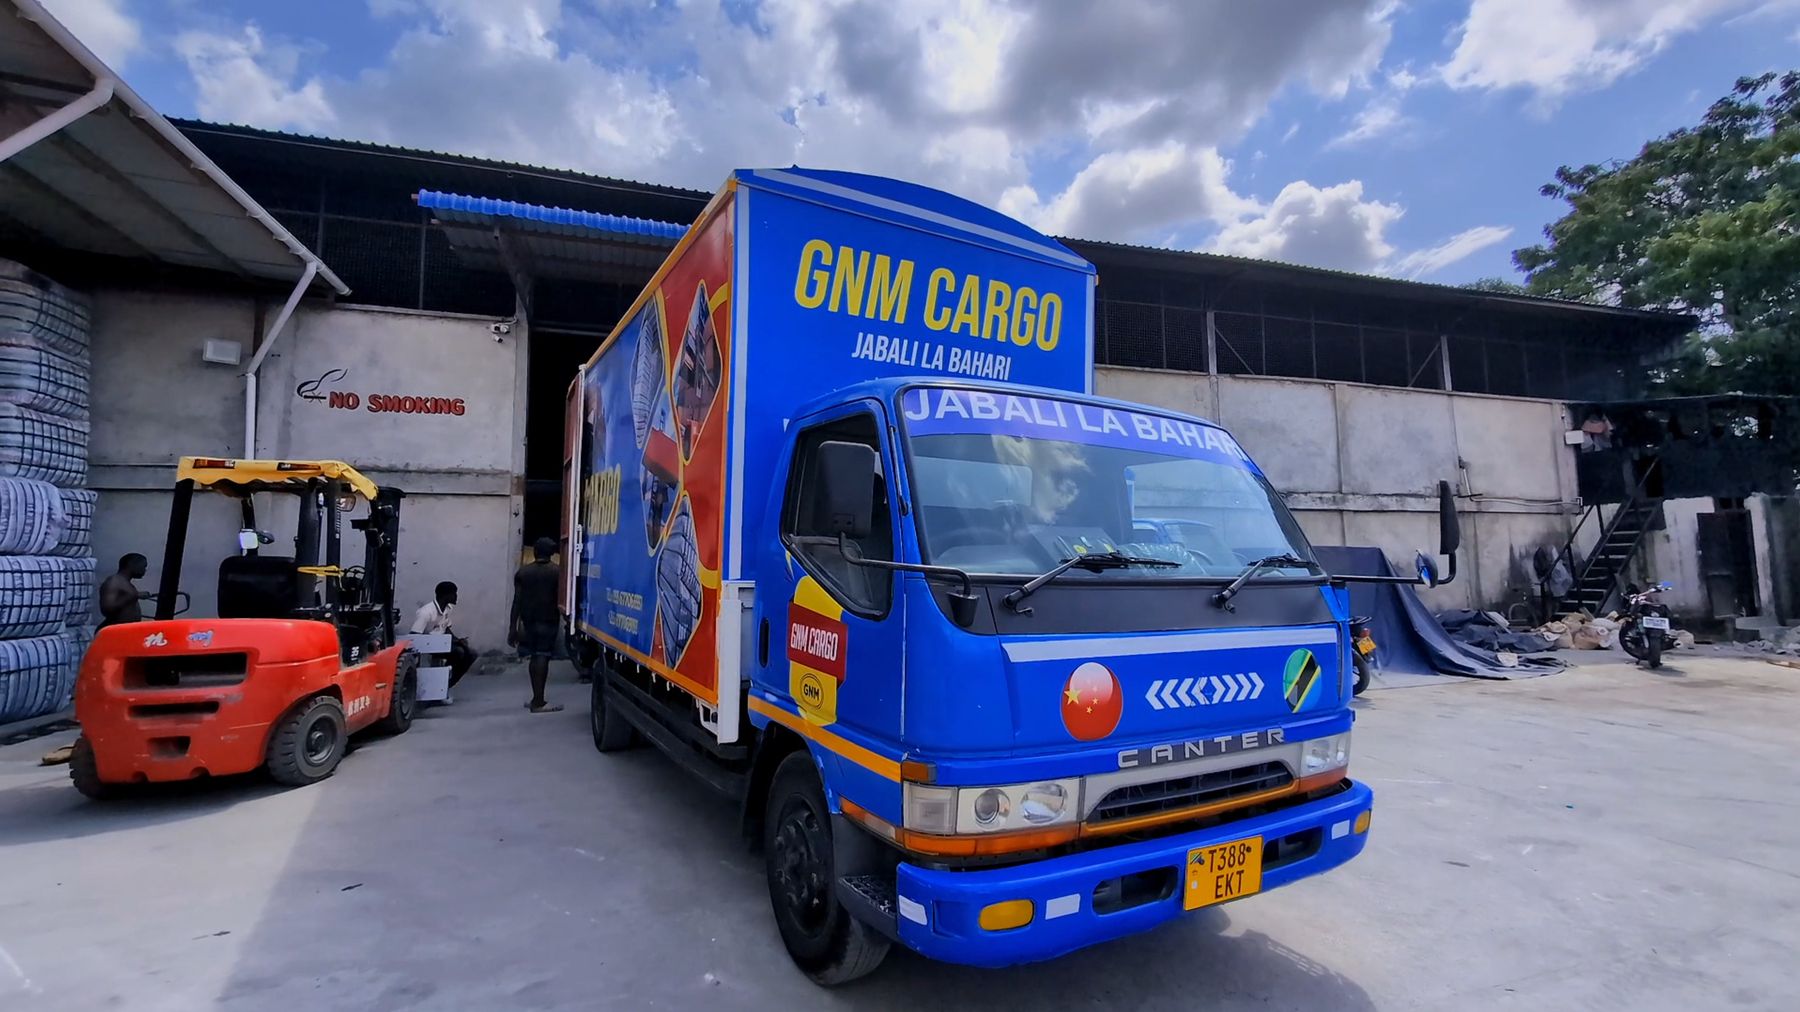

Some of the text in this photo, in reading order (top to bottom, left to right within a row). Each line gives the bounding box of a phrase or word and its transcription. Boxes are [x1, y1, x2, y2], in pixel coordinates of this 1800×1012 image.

[794, 239, 1063, 351] GNM CARGO
[851, 332, 1012, 381] JABALI LA BAHARI
[329, 390, 466, 416] NO SMOKING
[905, 388, 1068, 428] JABALI
[1074, 404, 1128, 437] LA
[790, 622, 838, 661] GNM CARGO
[803, 683, 820, 701] GNM
[1117, 728, 1285, 769] CANTER
[1208, 843, 1246, 873] T388
[1215, 870, 1245, 899] EKT
